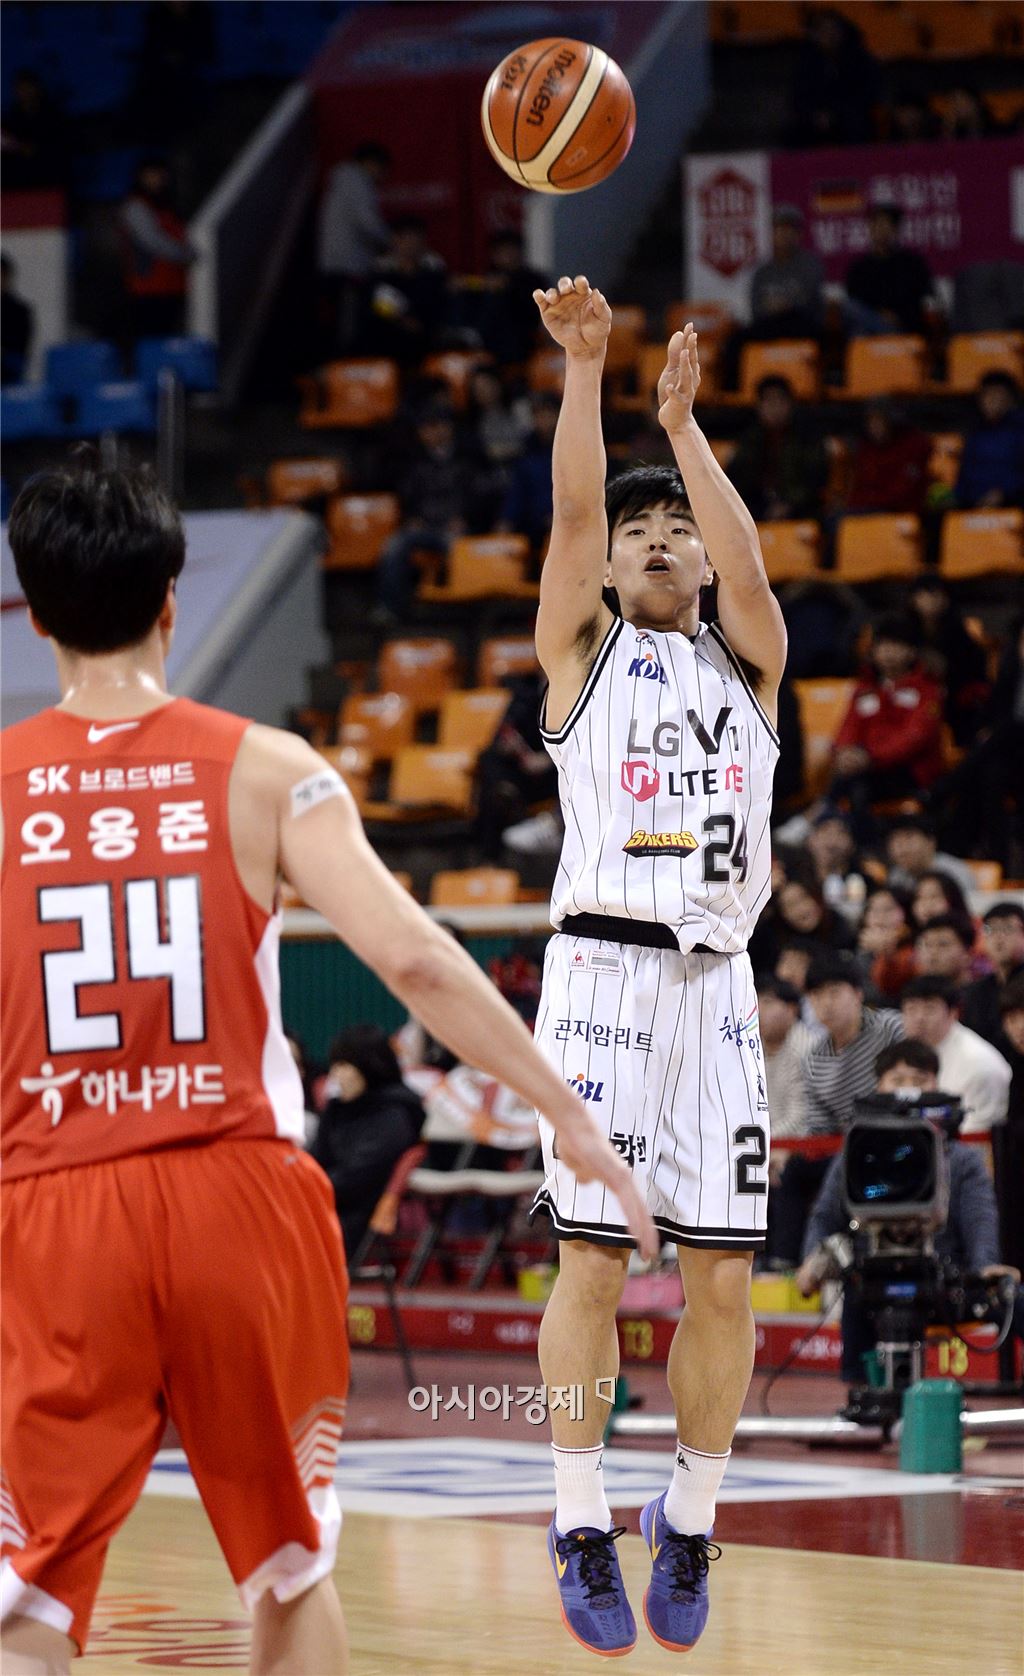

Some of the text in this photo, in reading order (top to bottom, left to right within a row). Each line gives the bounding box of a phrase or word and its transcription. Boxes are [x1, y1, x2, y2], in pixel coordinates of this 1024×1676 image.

[526, 48, 577, 127] molten
[627, 653, 667, 685] KBL
[627, 718, 681, 757] LG
[27, 761, 196, 796] SK 브로드밴드
[668, 769, 718, 797] LTE
[626, 829, 699, 849] SAKERS
[701, 812, 748, 885] 24
[37, 873, 207, 1056] 24
[82, 1062, 226, 1114] 하나카드
